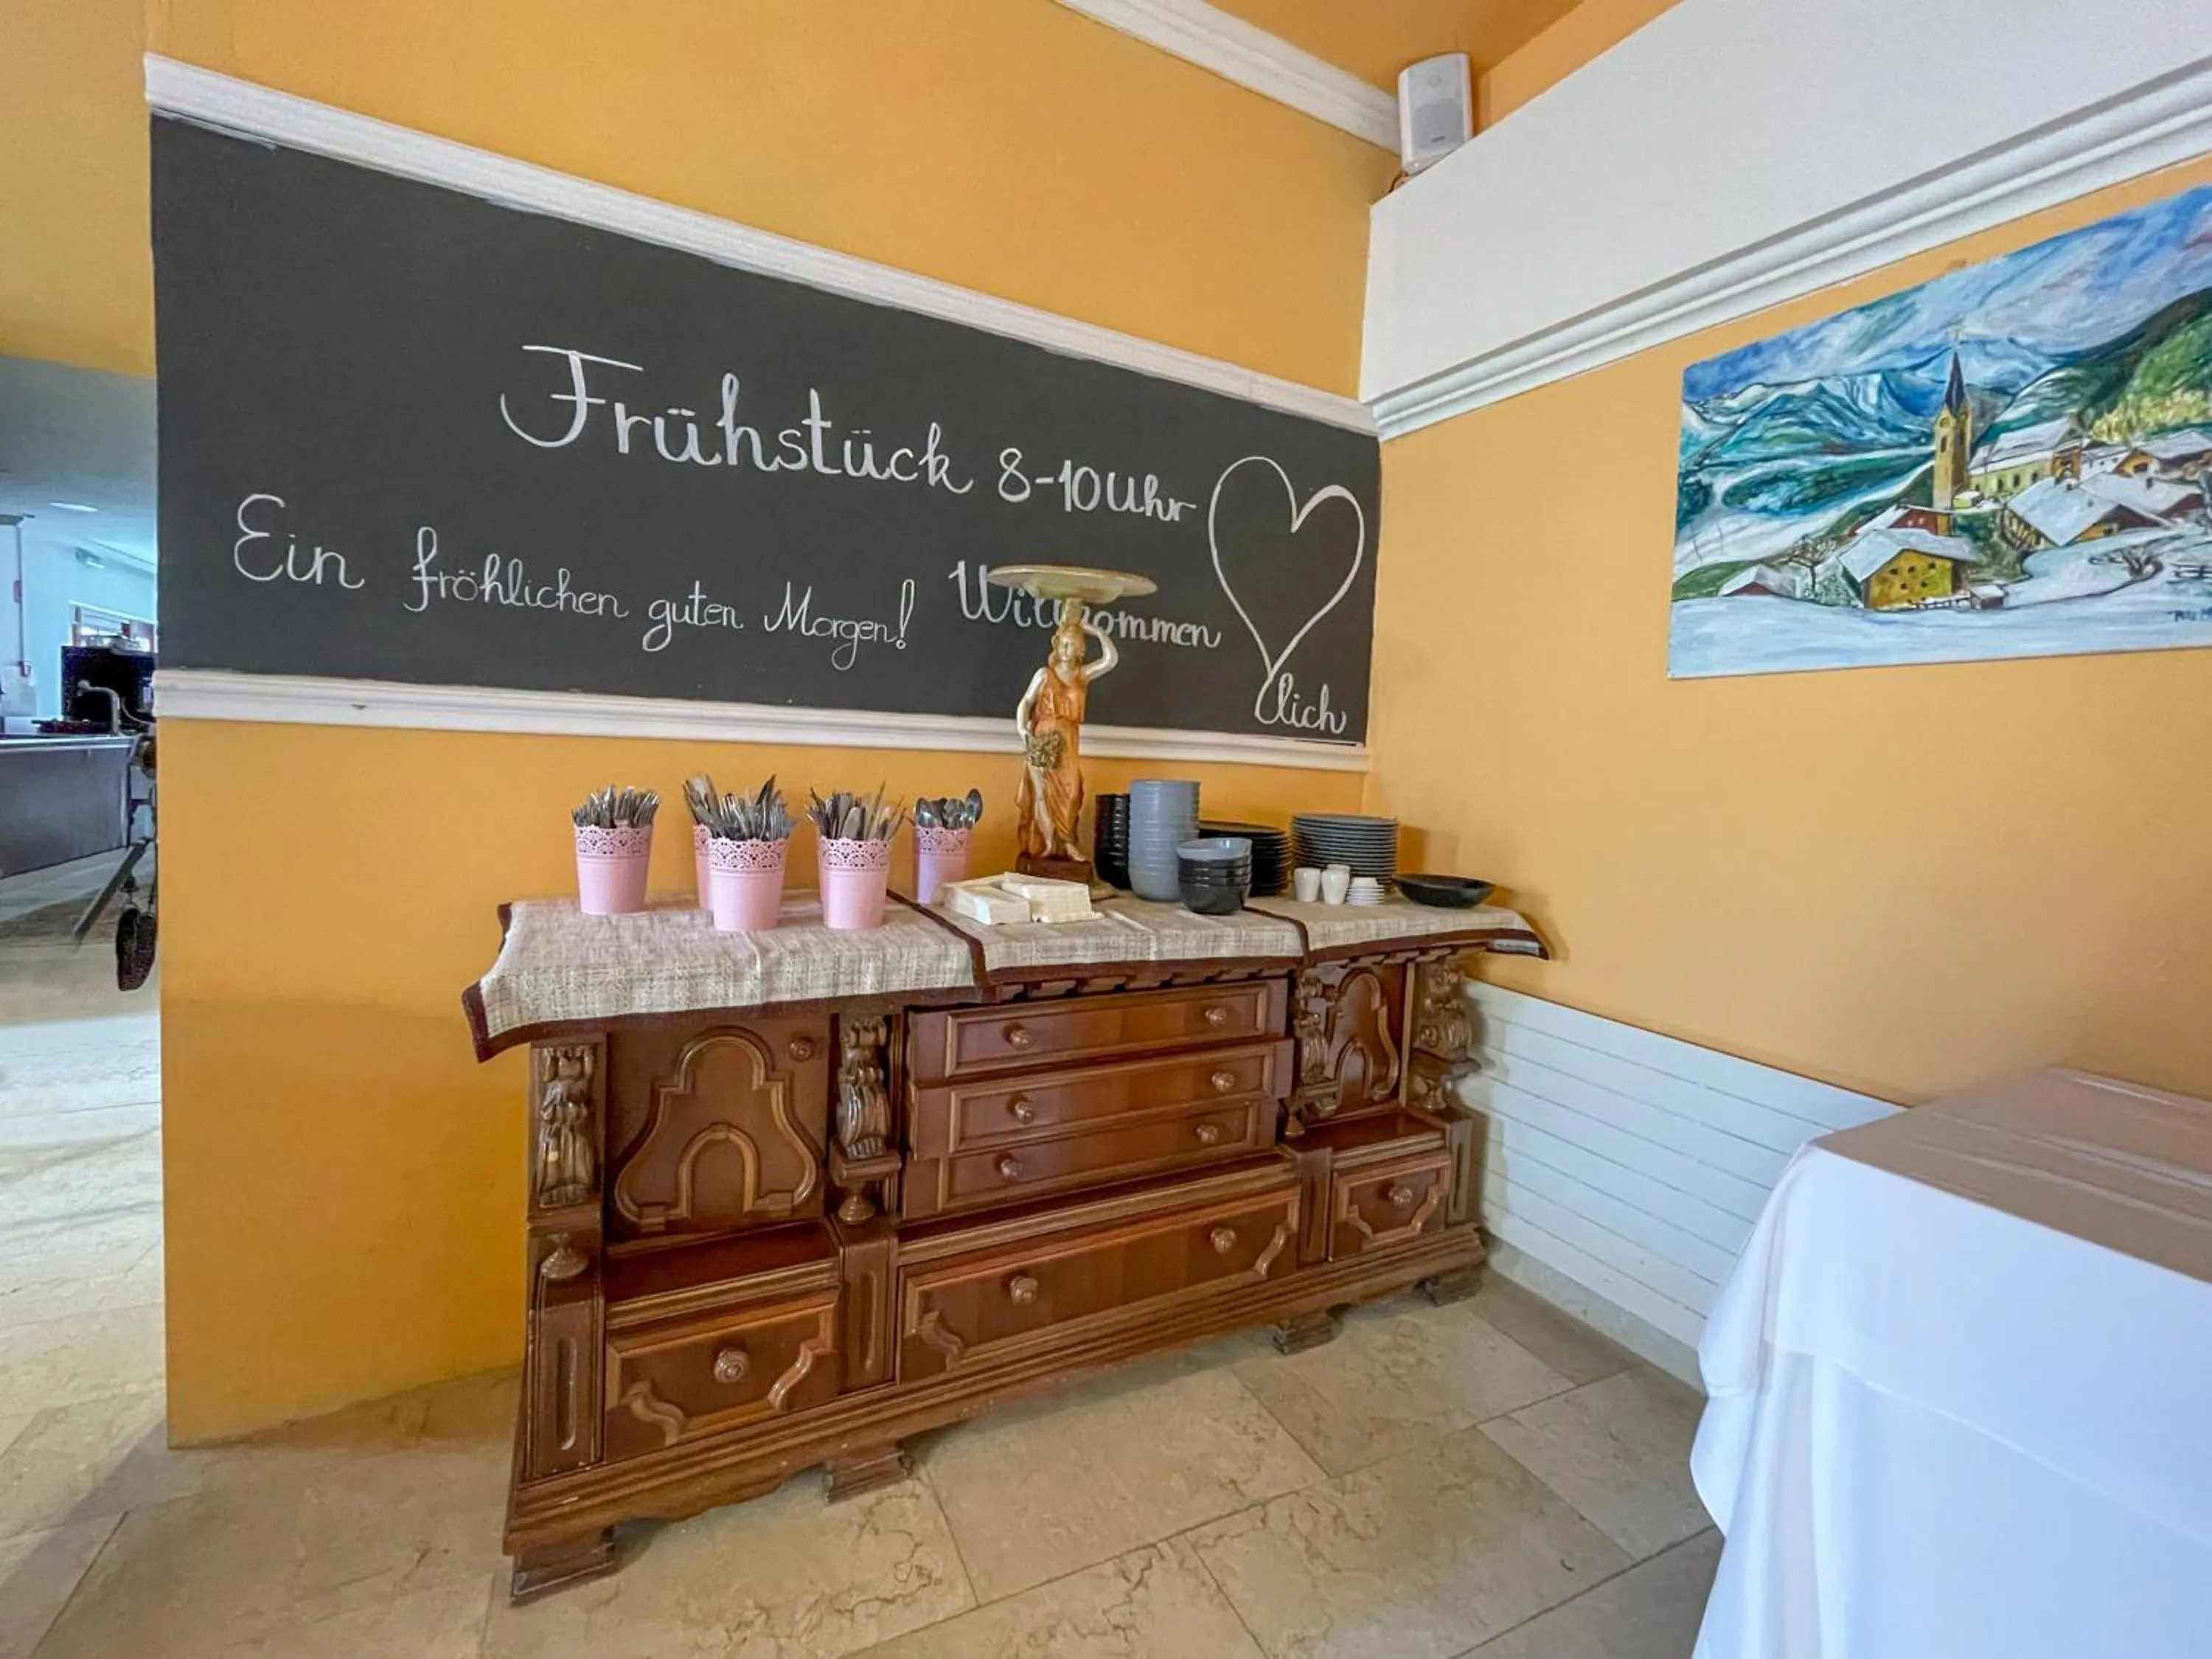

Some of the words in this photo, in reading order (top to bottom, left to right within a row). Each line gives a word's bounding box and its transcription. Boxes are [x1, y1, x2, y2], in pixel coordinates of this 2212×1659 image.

[500, 344, 973, 493] Frühstück
[233, 493, 366, 589] Ein
[404, 526, 629, 617] fröhlichen
[642, 580, 744, 652] guten
[764, 580, 915, 671] Morgen!
